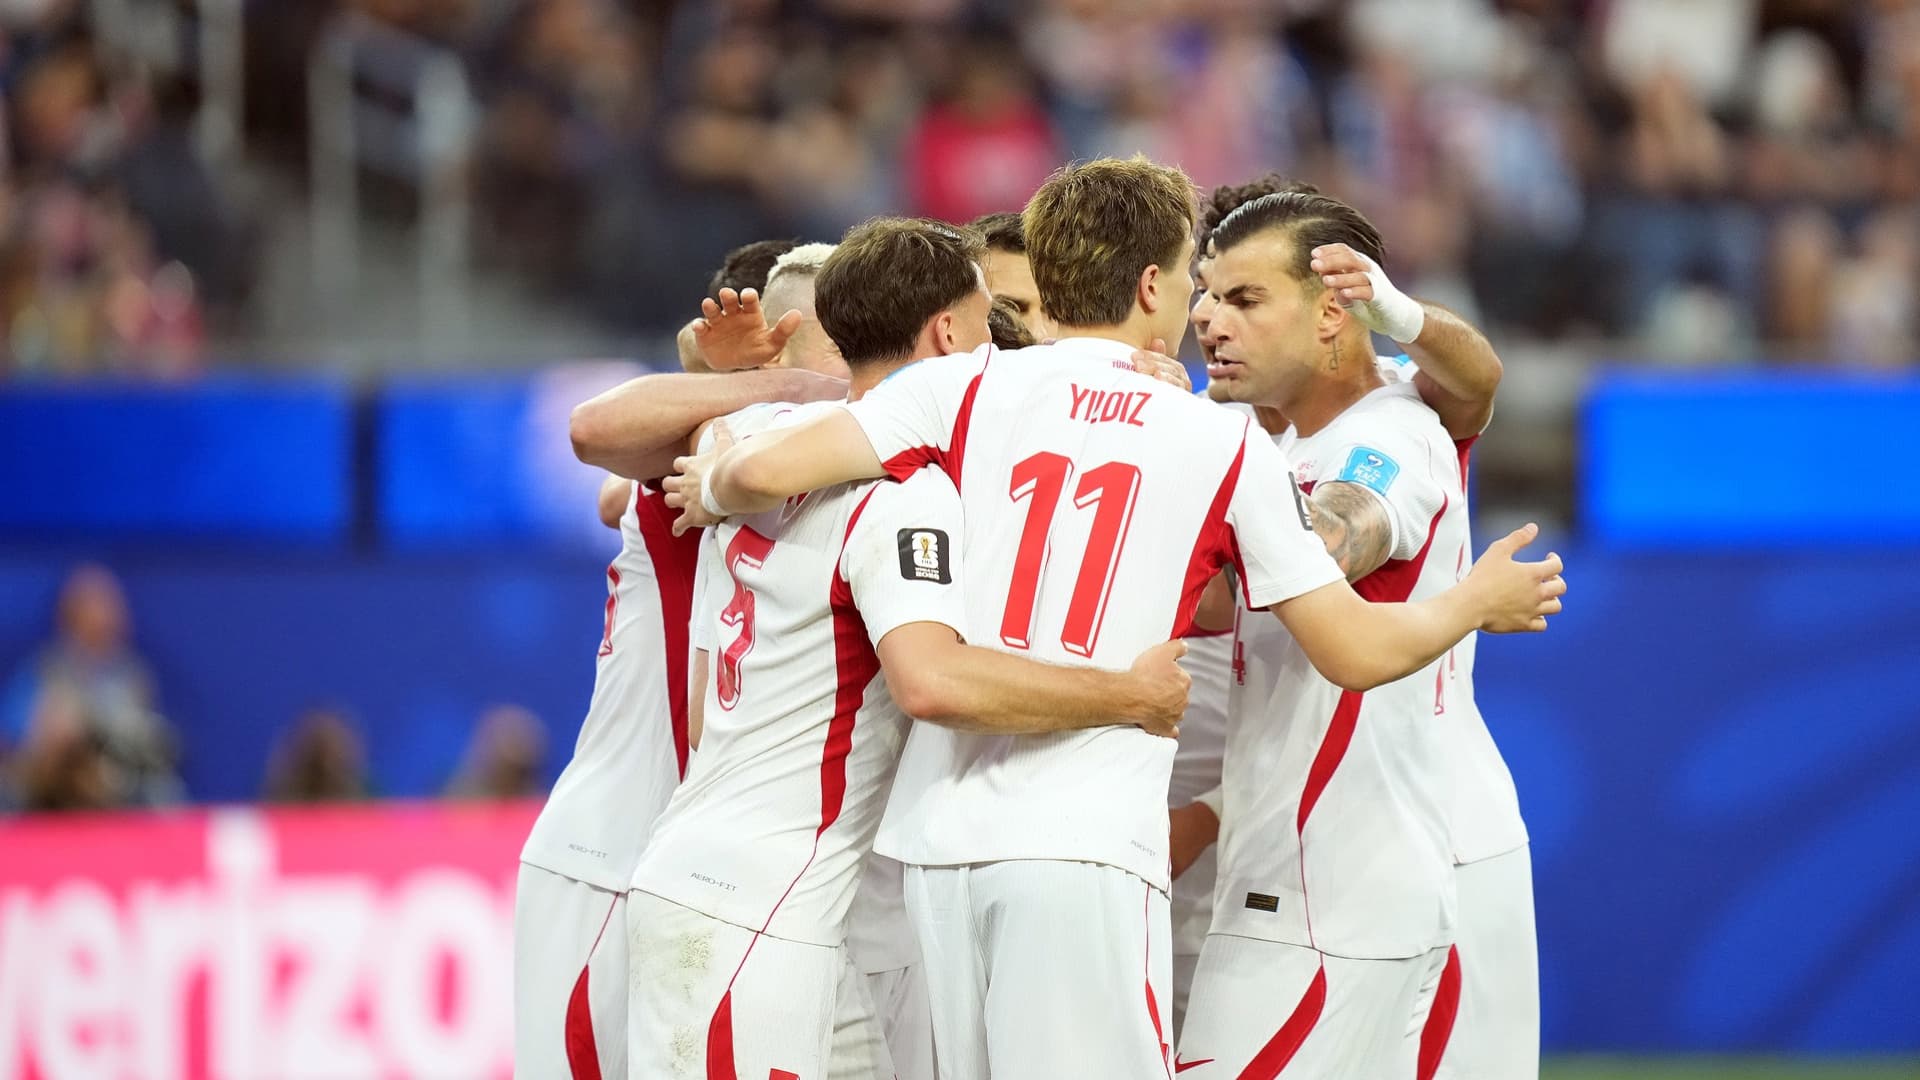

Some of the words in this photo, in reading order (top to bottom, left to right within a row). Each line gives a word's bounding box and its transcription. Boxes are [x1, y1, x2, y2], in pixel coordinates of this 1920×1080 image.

[1069, 383, 1152, 427] YILDIZ
[1000, 451, 1142, 659] 11
[716, 523, 776, 712] 5
[690, 872, 736, 891] AERO-FIT
